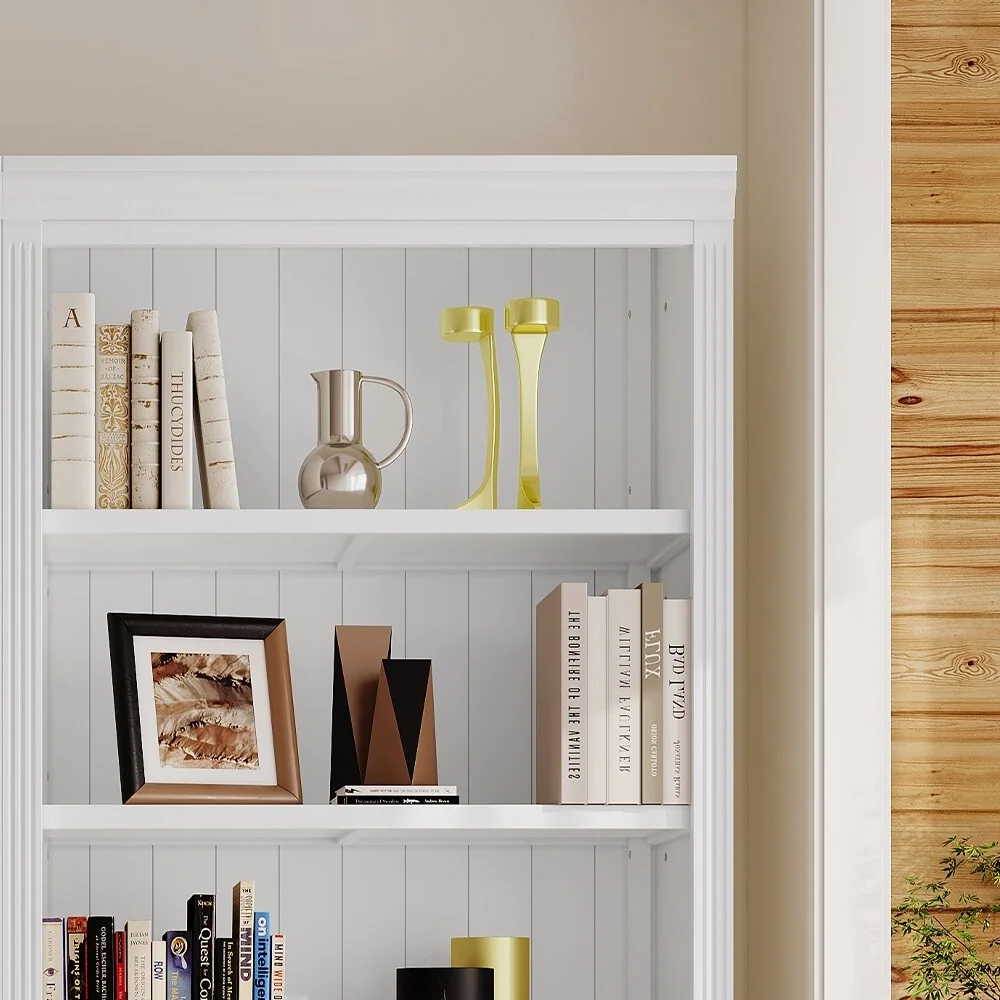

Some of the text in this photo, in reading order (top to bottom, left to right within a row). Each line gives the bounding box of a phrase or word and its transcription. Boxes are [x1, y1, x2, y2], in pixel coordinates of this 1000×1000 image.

[63, 308, 81, 328] A
[170, 371, 184, 472] THUCYDIDES
[257, 917, 266, 936] on
[199, 927, 211, 967] Quest
[227, 941, 233, 950] In
[240, 928, 252, 982] MIND
[273, 944, 283, 967] MIND
[154, 961, 163, 980] FLOW
[273, 970, 283, 992] WIDE
[74, 979, 81, 990] OF
